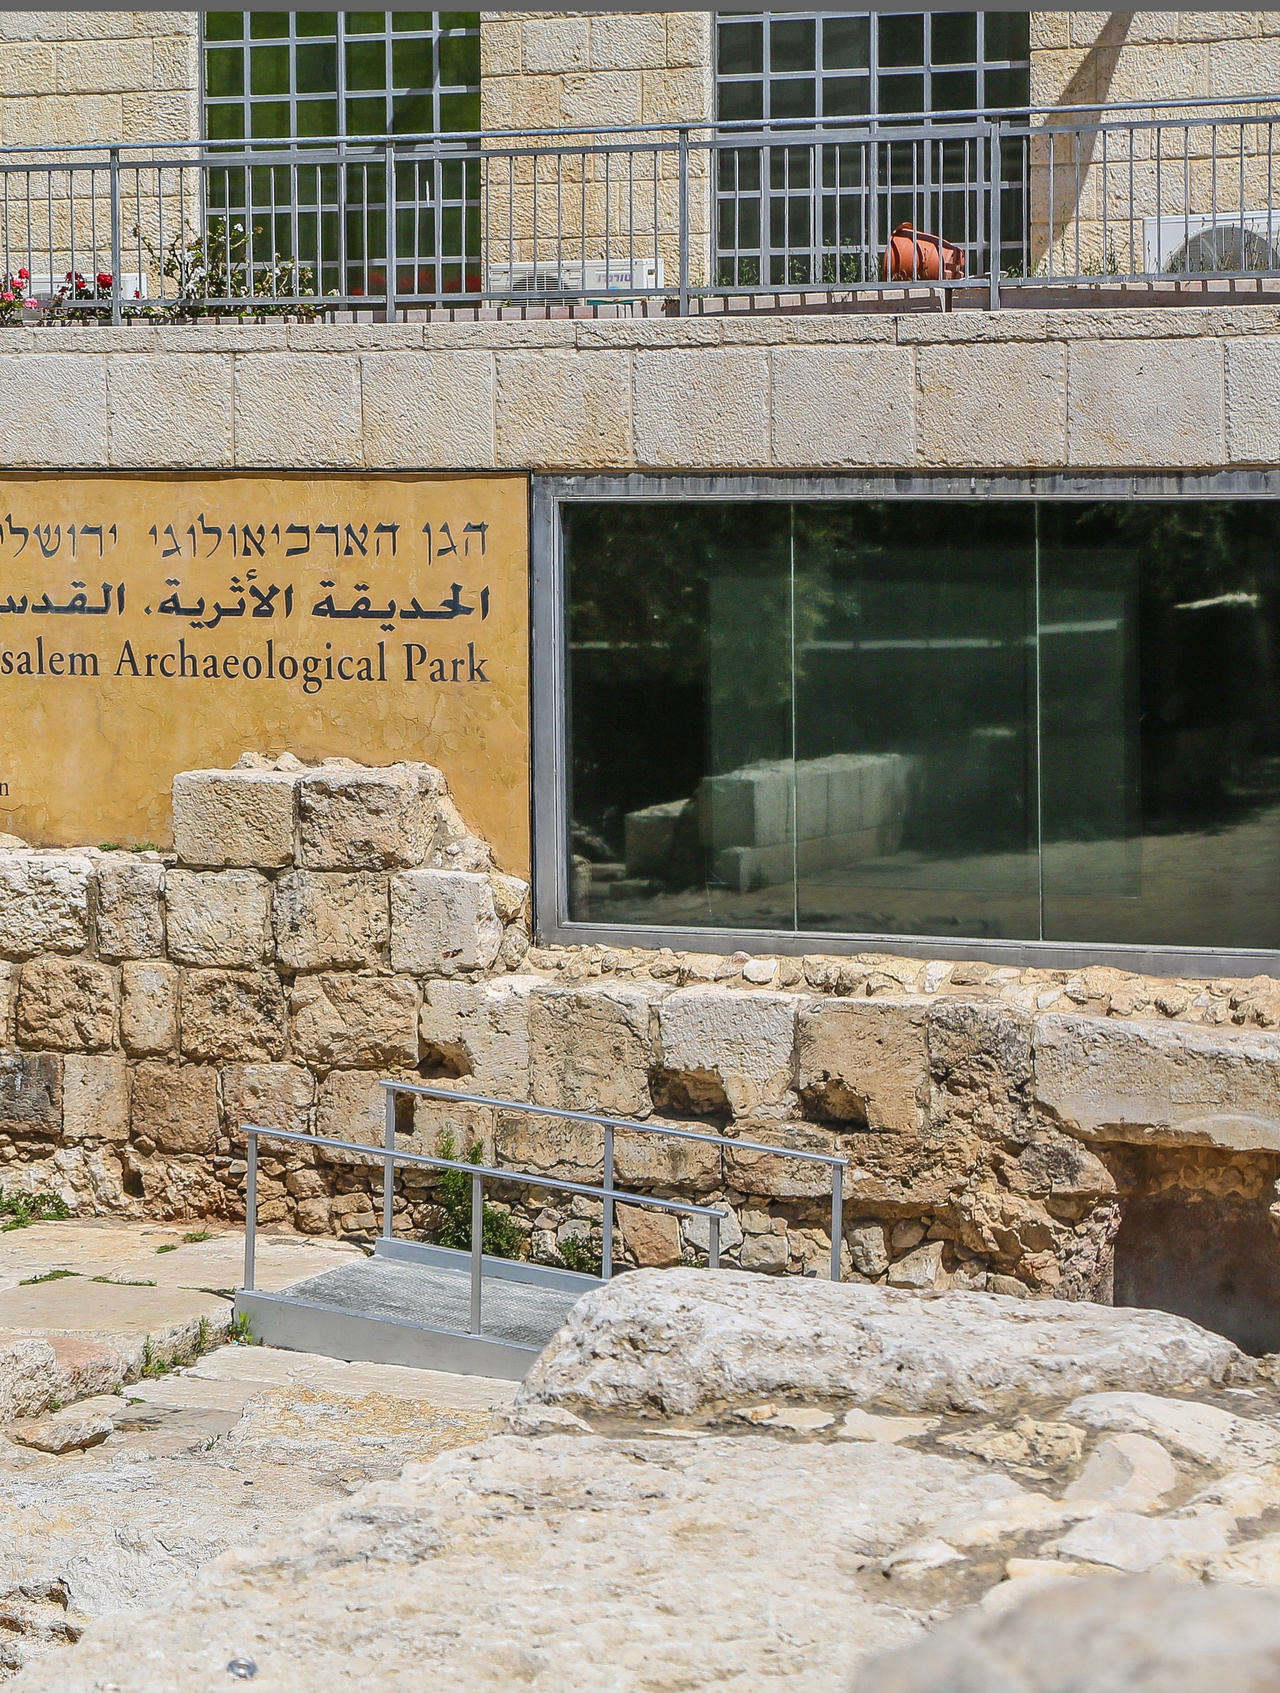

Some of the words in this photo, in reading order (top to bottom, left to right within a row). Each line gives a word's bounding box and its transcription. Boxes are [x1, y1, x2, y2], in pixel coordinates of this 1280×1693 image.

[148, 512, 400, 558] הארכיאולוגי
[422, 521, 489, 566] הגן
[311, 580, 490, 632] الحديقة
[113, 638, 388, 694] Archaeological
[402, 641, 490, 683] Park
